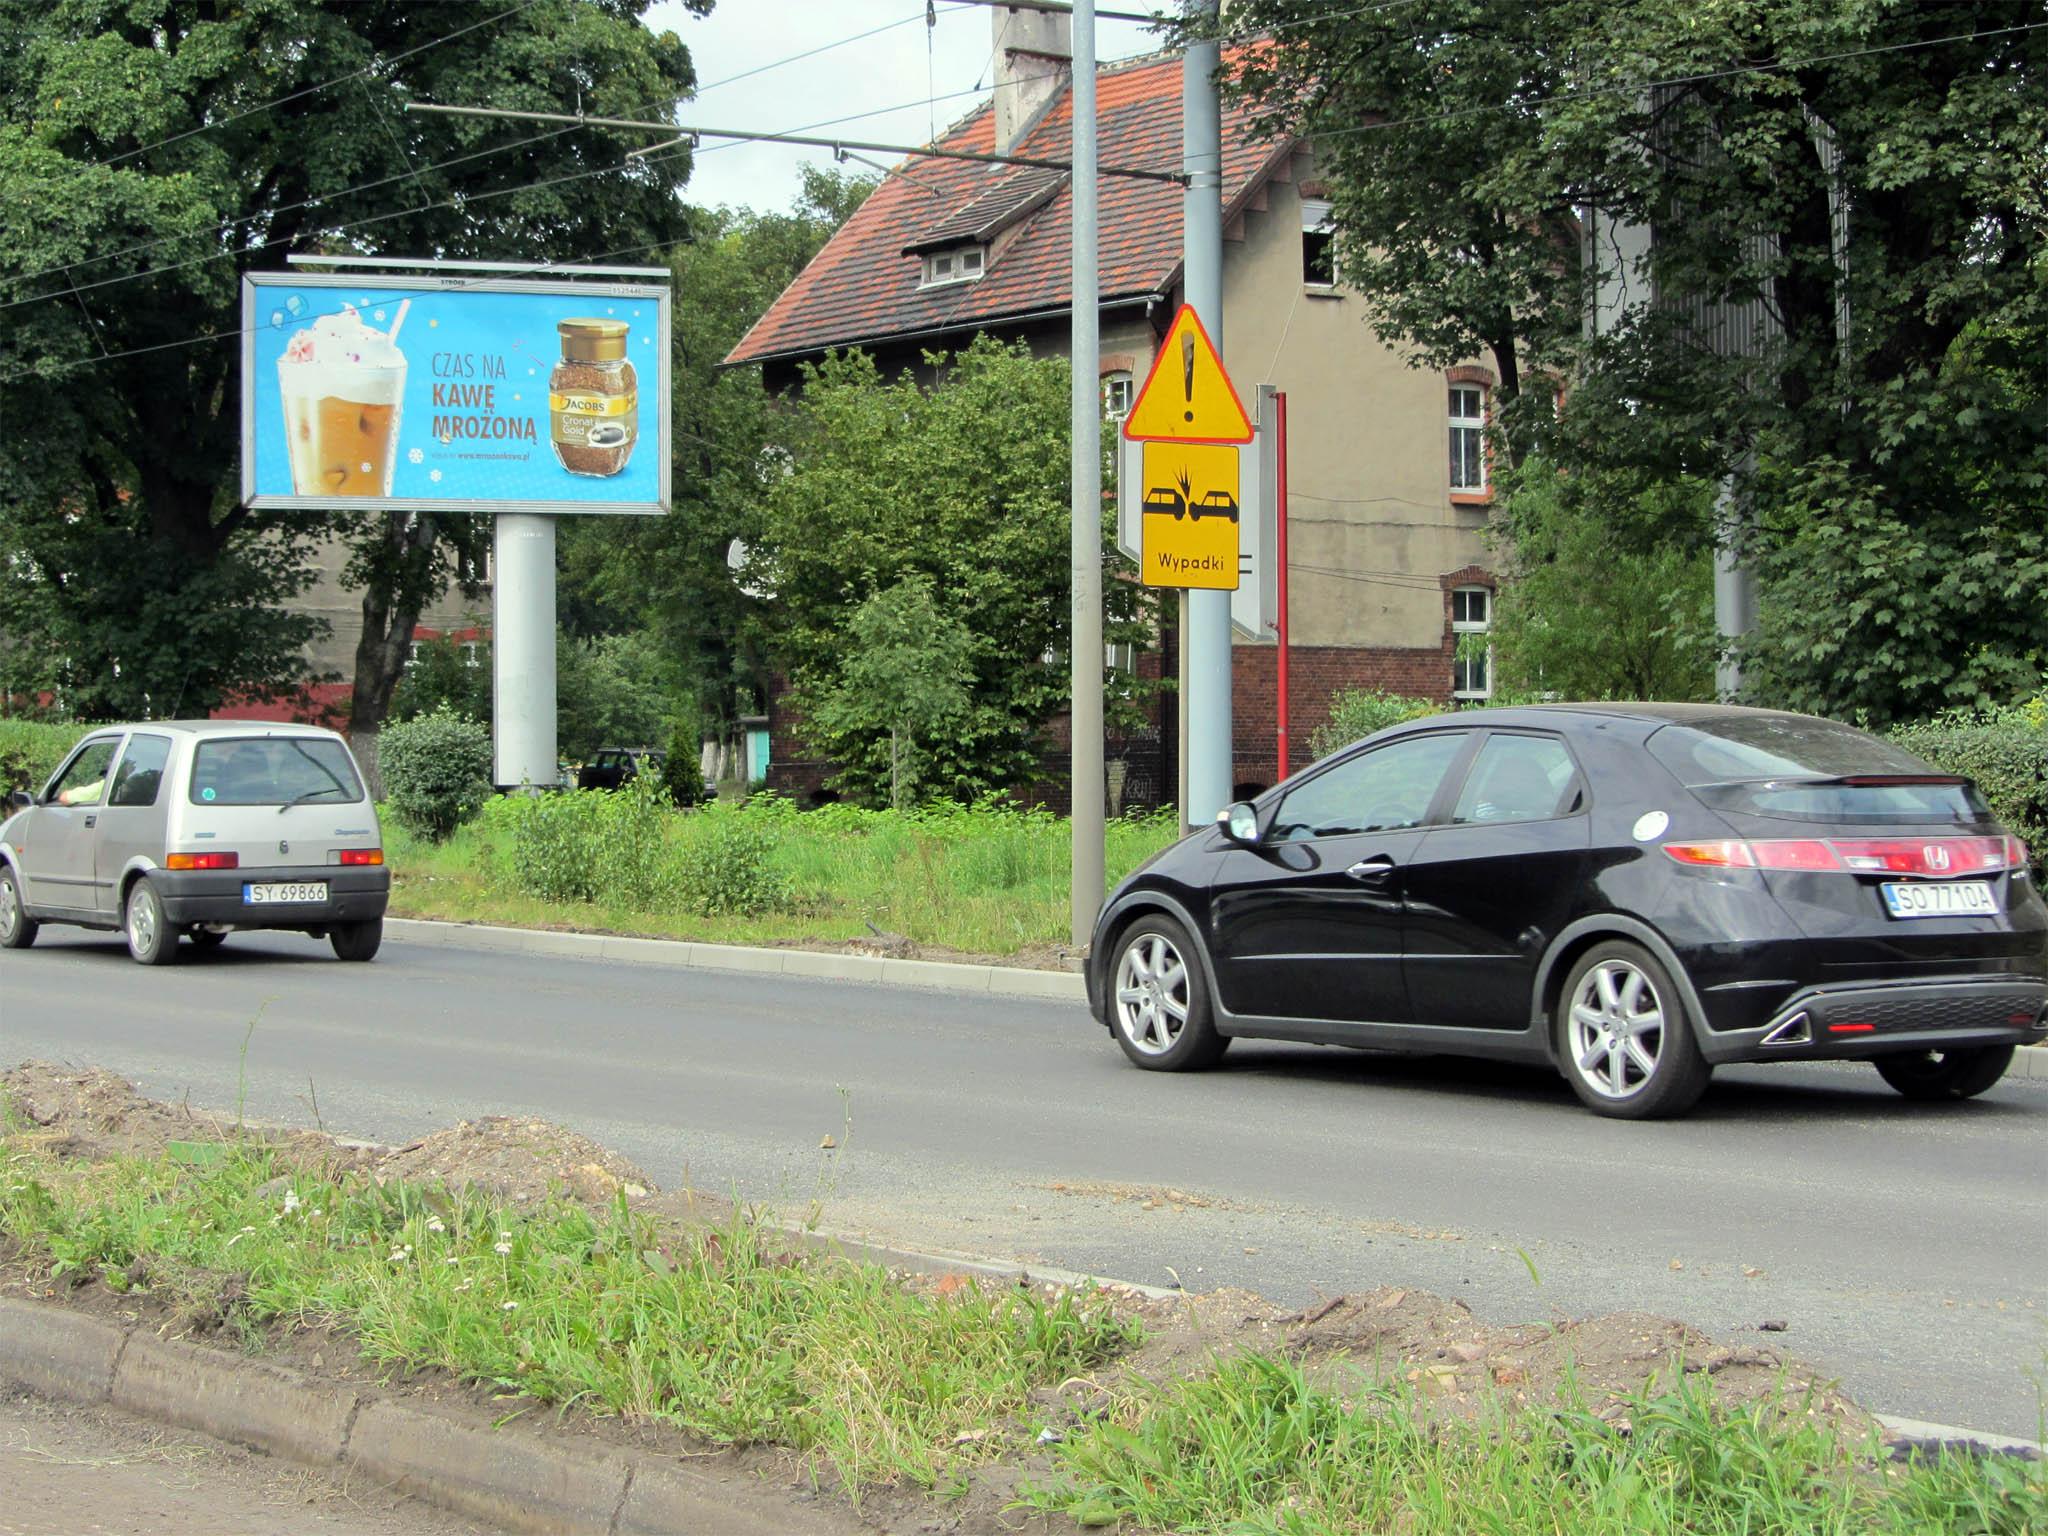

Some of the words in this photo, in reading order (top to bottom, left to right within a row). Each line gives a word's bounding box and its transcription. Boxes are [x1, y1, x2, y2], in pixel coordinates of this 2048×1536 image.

[432, 352, 474, 378] CZAS
[483, 353, 506, 379] NA
[432, 383, 495, 414] KAWĘ
[560, 398, 605, 412] JACOBS
[432, 409, 537, 445] MROŻONĄ
[562, 424, 585, 435] Gold
[1158, 552, 1224, 573] Wypadki
[253, 886, 273, 901] SY
[280, 885, 325, 900] 69866
[1929, 885, 1993, 908] 7710A
